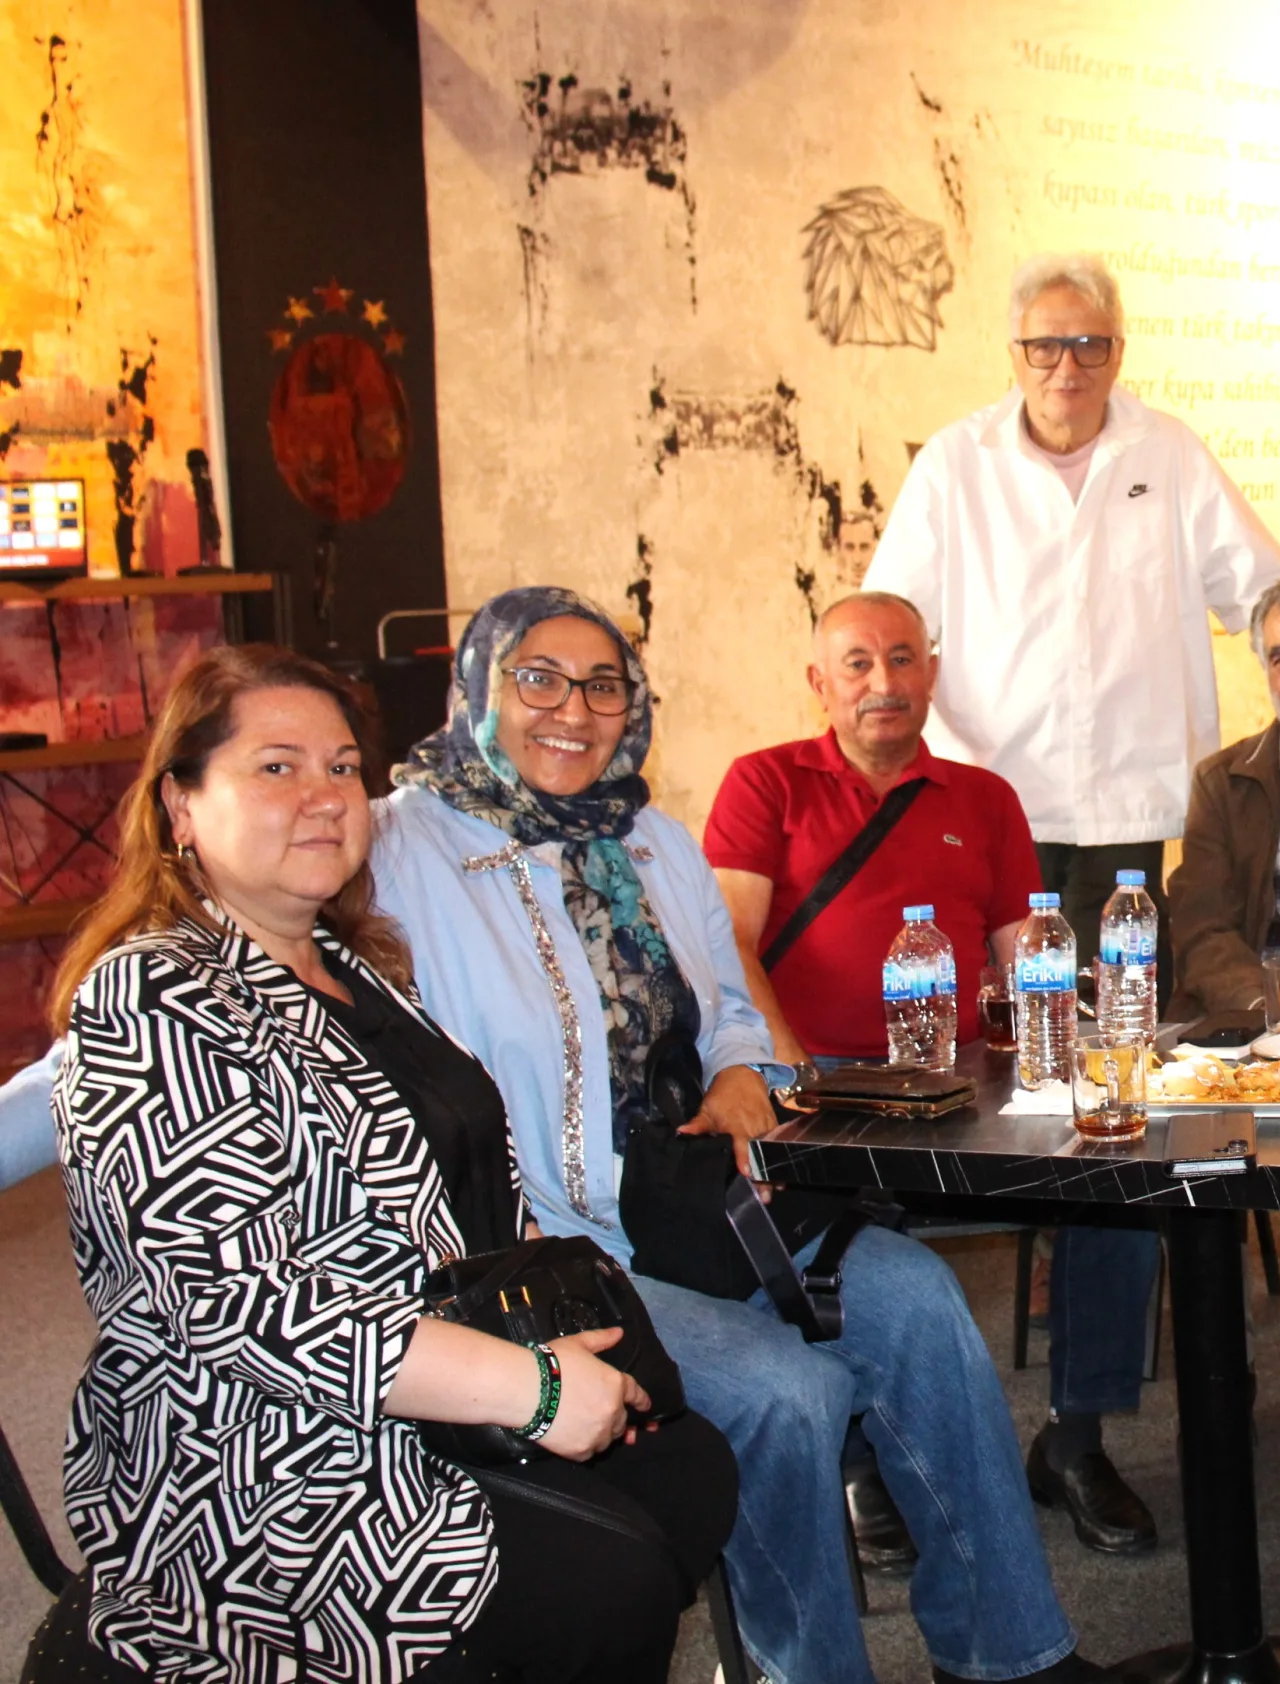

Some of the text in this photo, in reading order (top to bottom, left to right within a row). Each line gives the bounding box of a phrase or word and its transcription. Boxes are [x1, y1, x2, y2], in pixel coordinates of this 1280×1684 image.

[1042, 168, 1119, 213] kupası
[1182, 309, 1230, 347] türk
[1162, 366, 1216, 410] kupa
